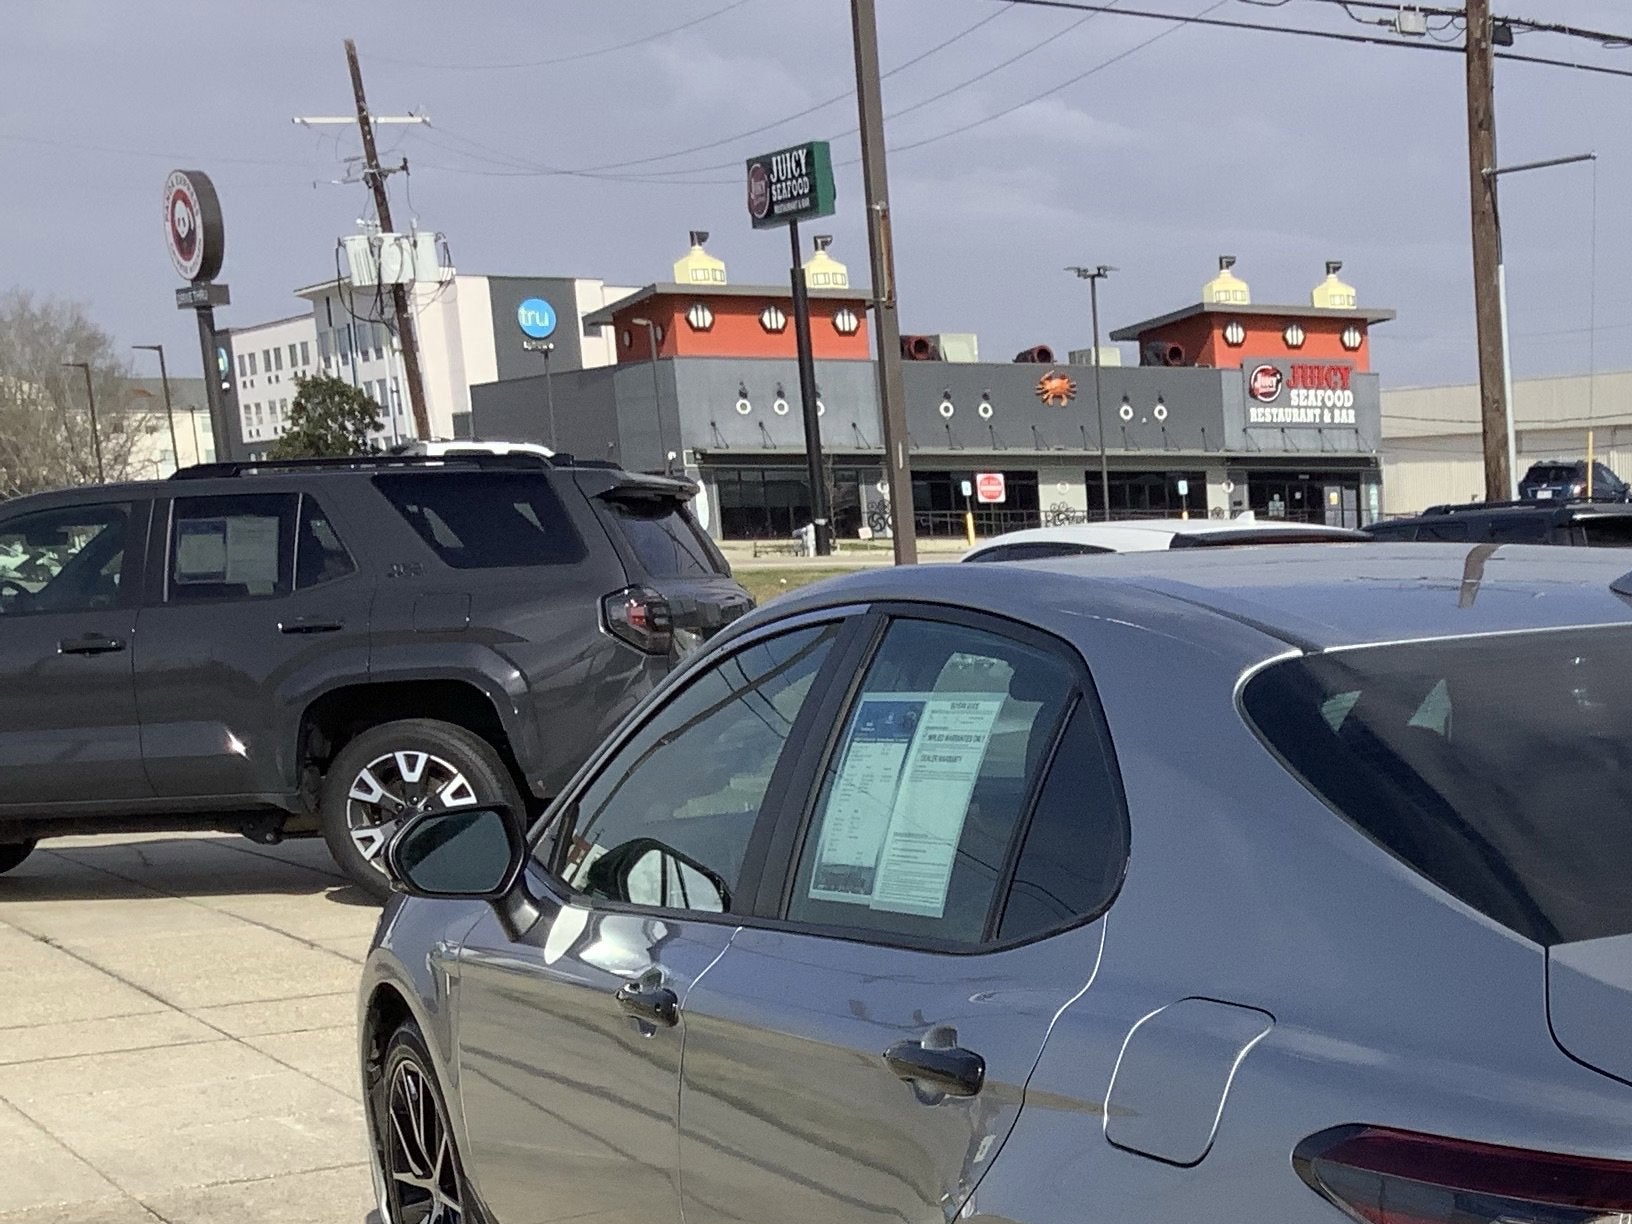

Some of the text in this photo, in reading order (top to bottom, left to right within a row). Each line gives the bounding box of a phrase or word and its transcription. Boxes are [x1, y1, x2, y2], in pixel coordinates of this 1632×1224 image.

[770, 149, 807, 183] JUICY
[771, 176, 810, 202] SEAFOOD
[518, 306, 549, 327] tru
[1285, 364, 1353, 390] JUICY
[1290, 388, 1354, 407] SEAFOOD
[1249, 407, 1356, 423] RESTAURANT & BAR
